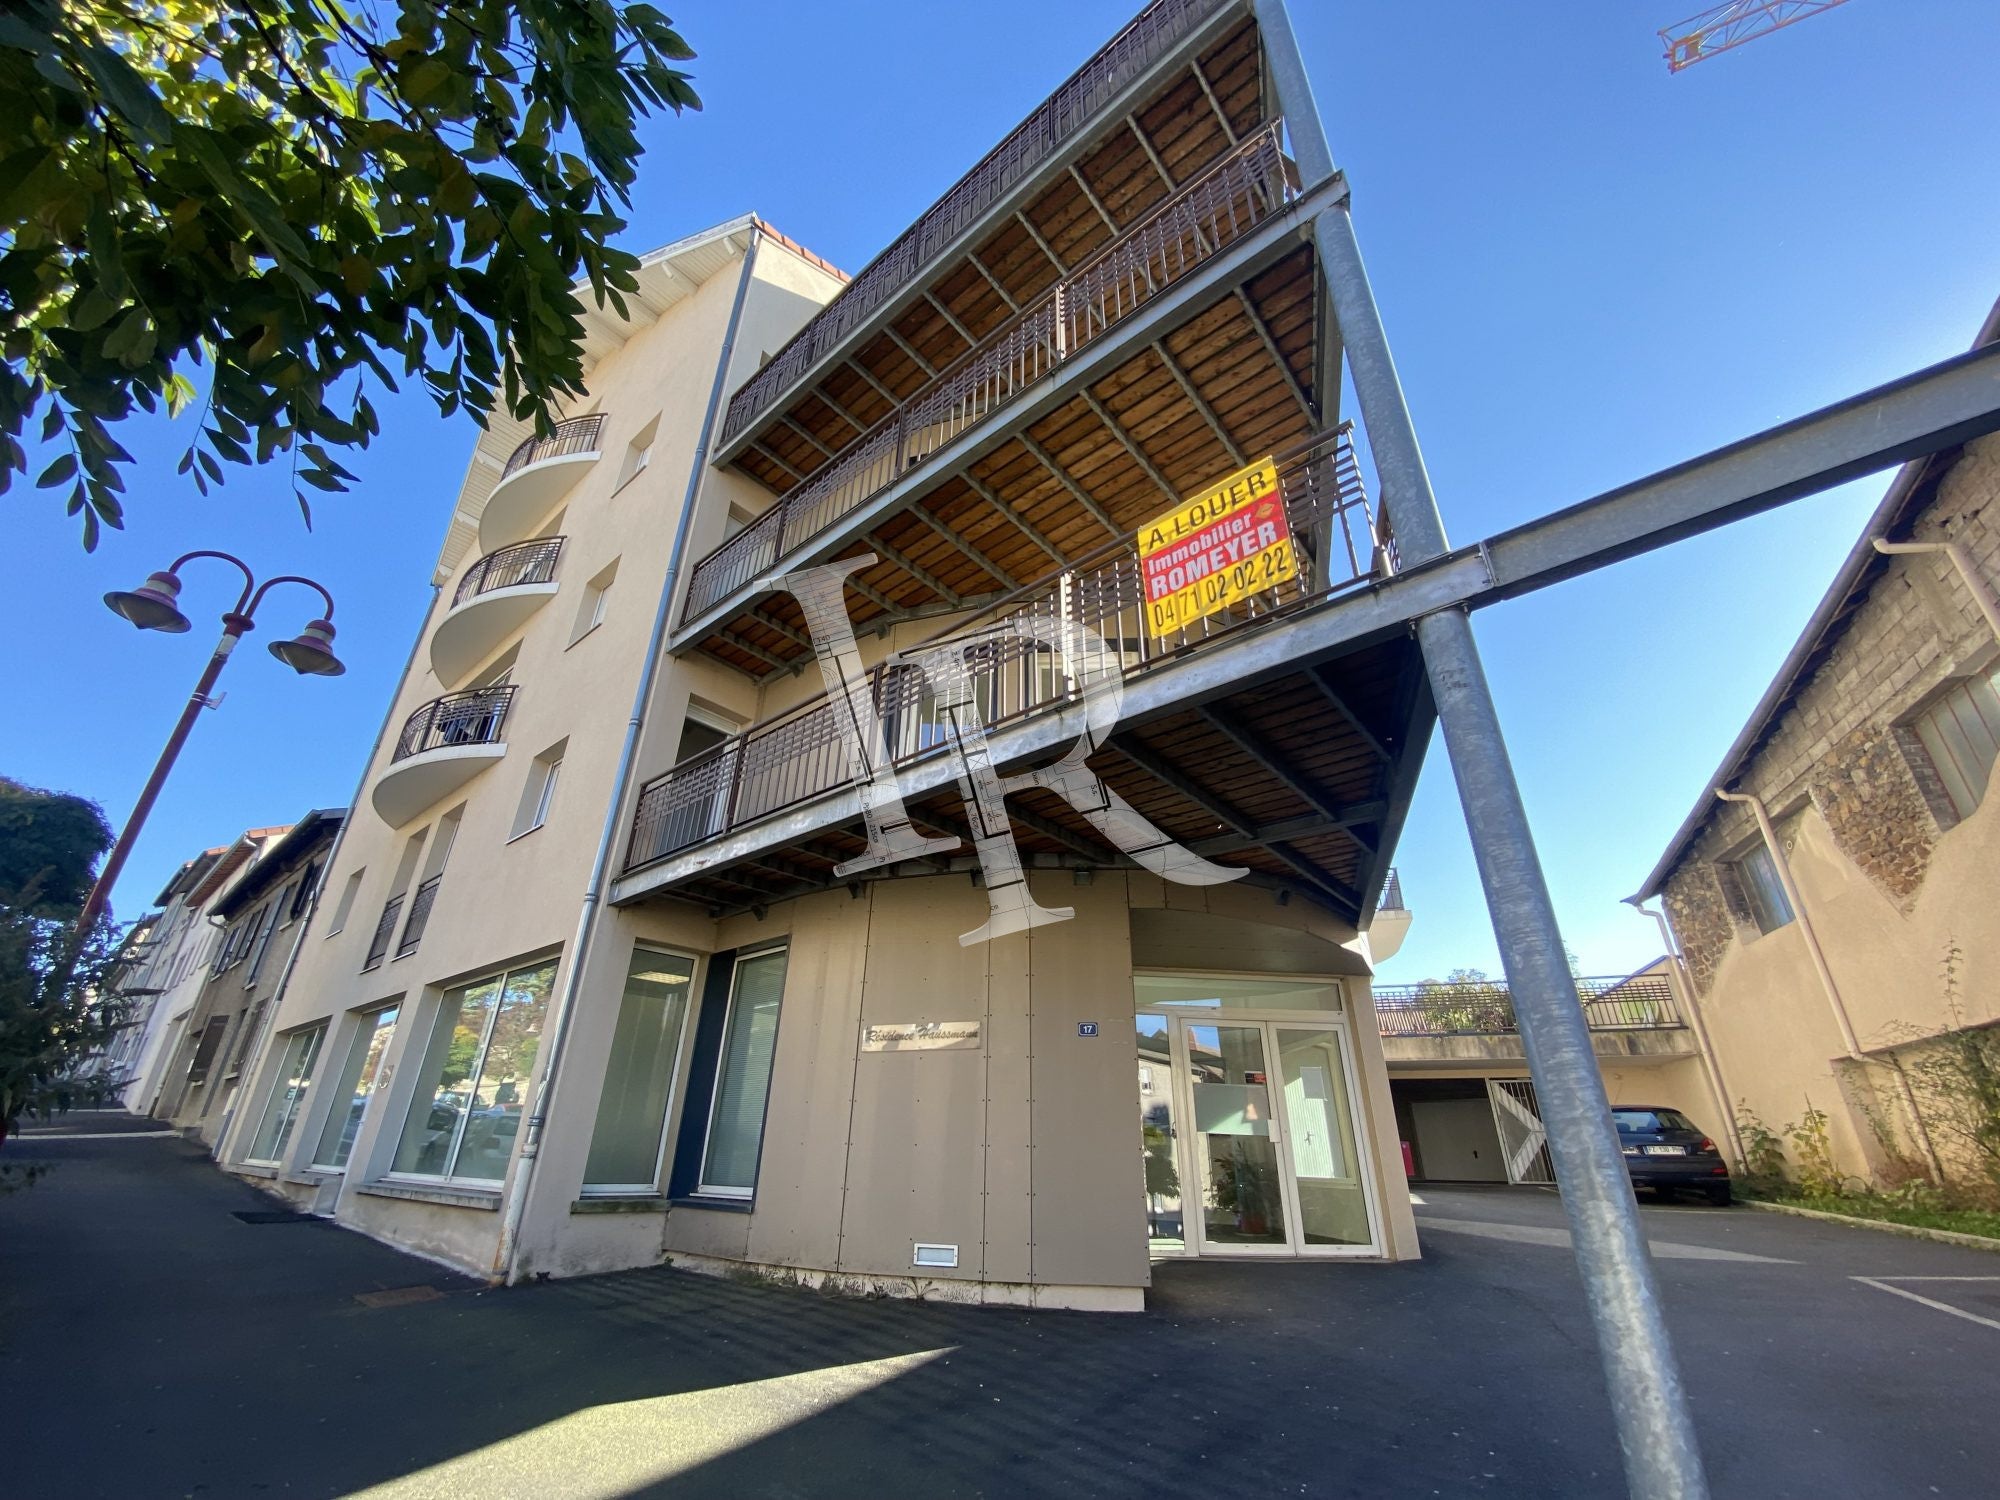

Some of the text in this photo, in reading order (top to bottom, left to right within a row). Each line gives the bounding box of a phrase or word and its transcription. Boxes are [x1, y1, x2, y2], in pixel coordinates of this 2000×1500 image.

[1149, 471, 1267, 549] A LOUER
[1149, 512, 1251, 575] Immobilier
[1151, 521, 1278, 600] ROMEYER
[1154, 546, 1288, 628] 04 71 02 02 22
[1083, 1025, 1093, 1034] 17
